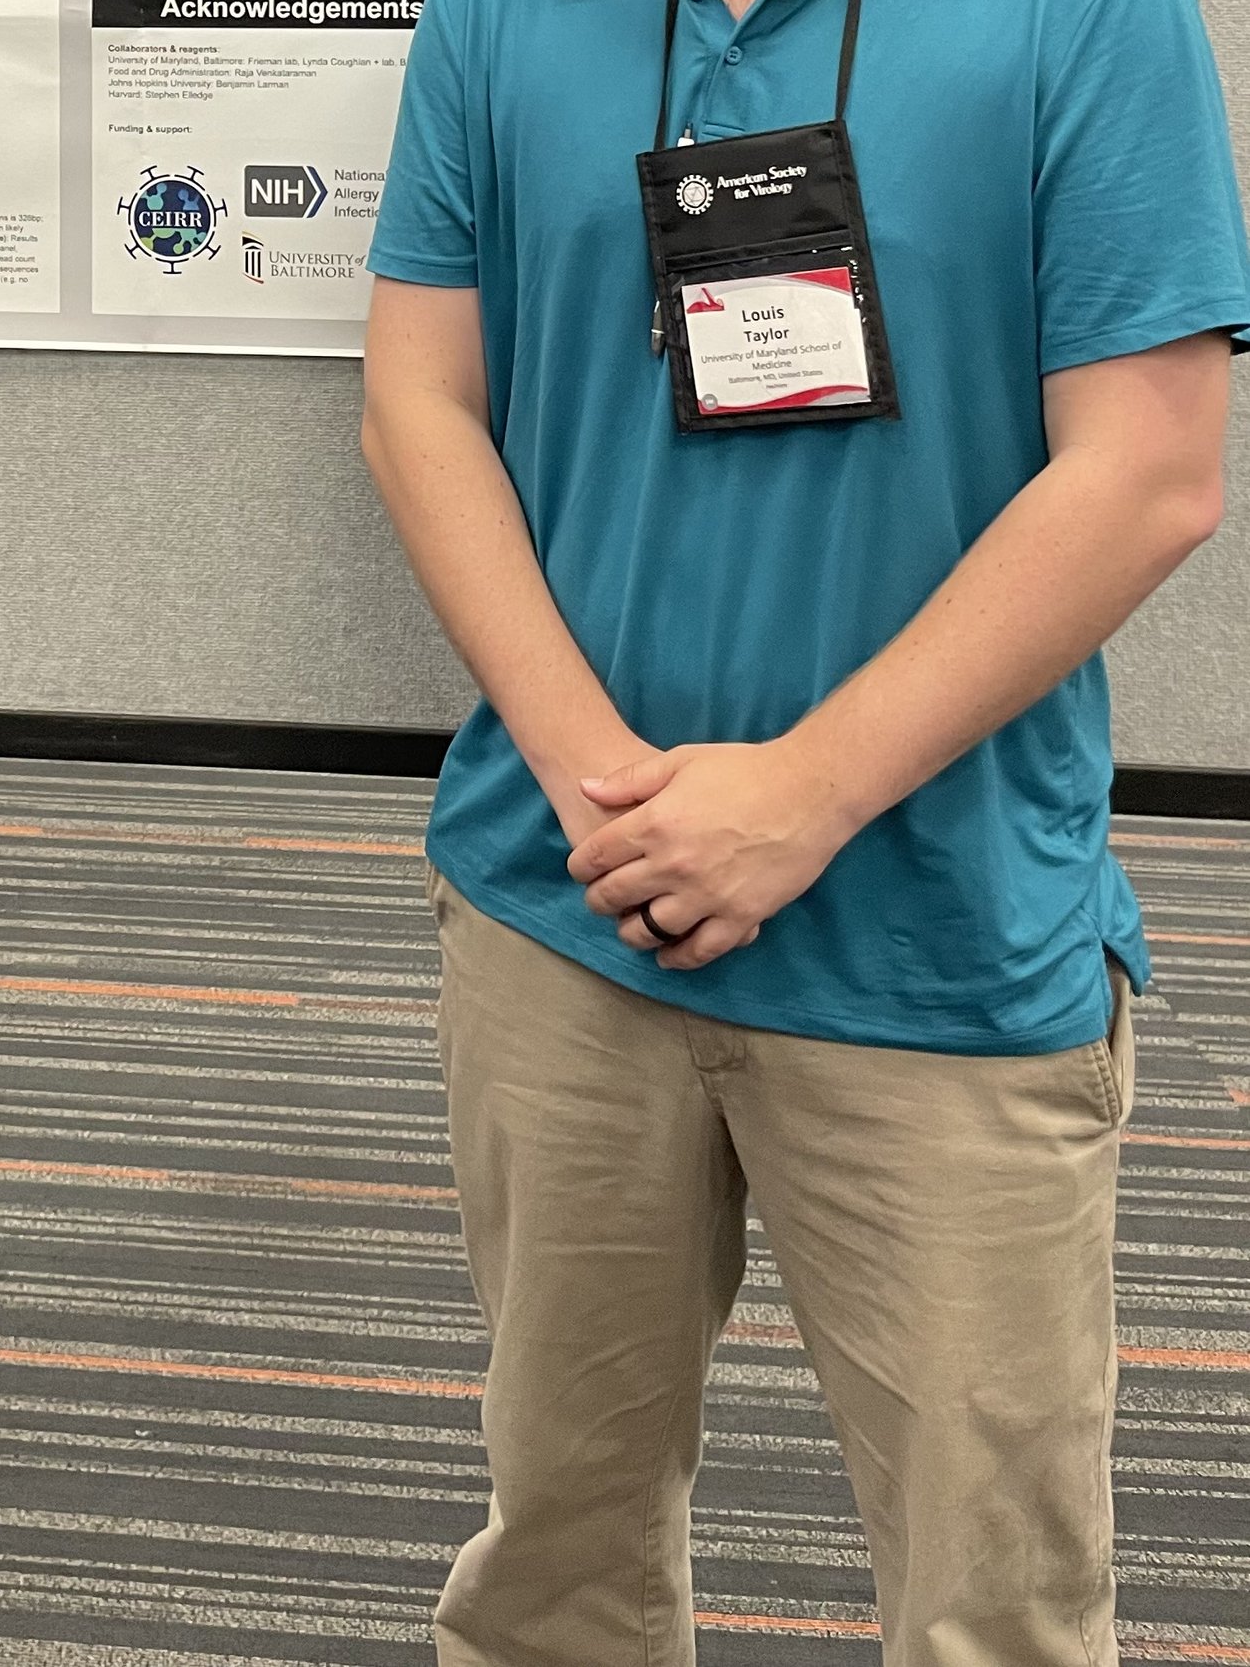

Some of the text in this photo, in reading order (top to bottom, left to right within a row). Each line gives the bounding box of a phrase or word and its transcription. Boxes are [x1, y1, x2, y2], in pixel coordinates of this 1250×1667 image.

[334, 170, 385, 181] Nationa
[717, 166, 807, 188] American Society
[251, 179, 304, 204] NIH
[334, 188, 379, 202] Allergy
[734, 182, 792, 199] for Virology
[139, 210, 202, 228] CEIRR
[271, 265, 355, 278] BALTIMORE
[742, 306, 784, 322] Louis
[743, 328, 789, 344] Taylor
[701, 340, 841, 364] University of Maryland School of
[752, 360, 791, 370] Medicine
